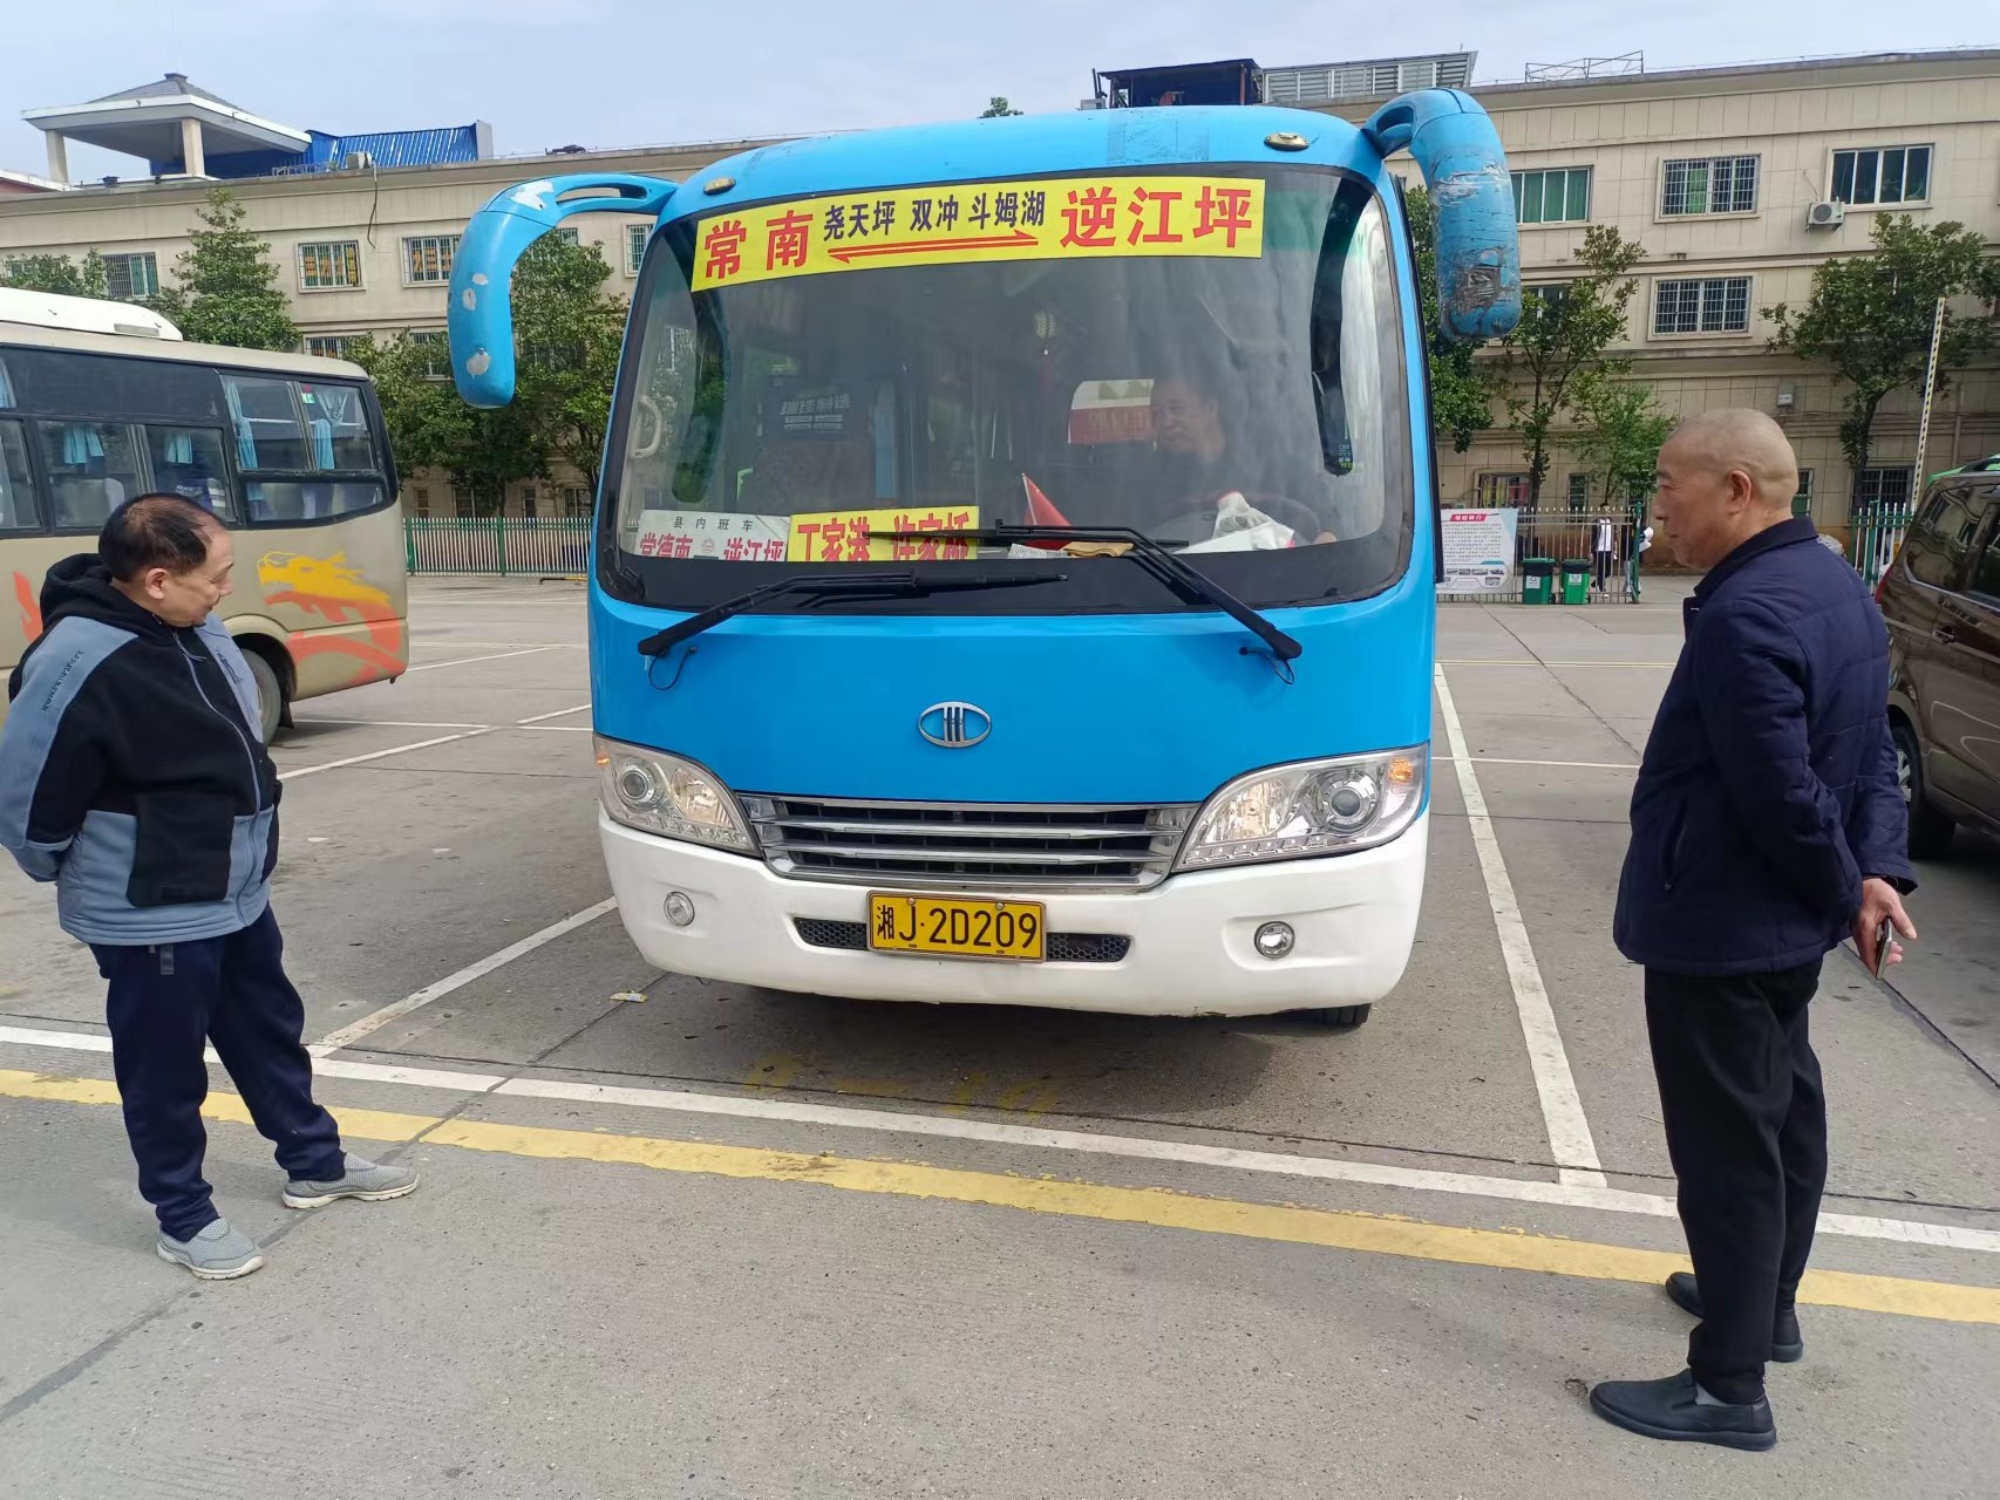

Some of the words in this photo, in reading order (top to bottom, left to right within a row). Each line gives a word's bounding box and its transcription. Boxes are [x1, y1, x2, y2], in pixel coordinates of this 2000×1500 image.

[704, 189, 814, 280] 常南
[823, 199, 896, 241] 尧天坪
[910, 194, 960, 232] 双冲
[967, 189, 1045, 230] 斗姆湖
[1059, 185, 1252, 248] 逆江坪
[673, 516, 754, 532] 县内班车
